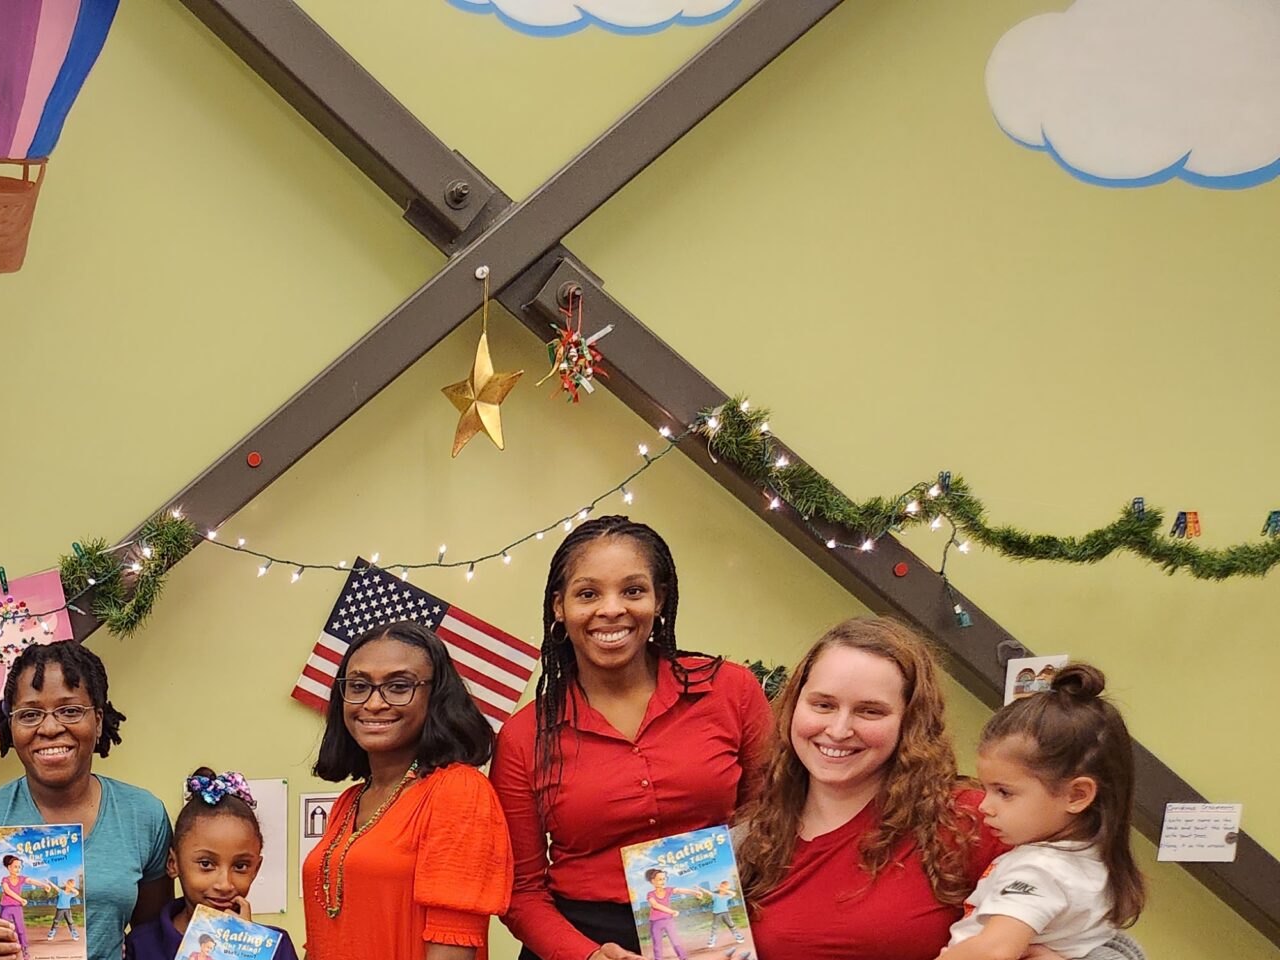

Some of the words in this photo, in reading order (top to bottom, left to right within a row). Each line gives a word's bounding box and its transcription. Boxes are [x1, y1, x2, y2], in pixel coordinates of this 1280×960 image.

[17, 830, 78, 854] Skating's
[657, 833, 725, 866] Skating's
[1008, 880, 1038, 893] NIKE
